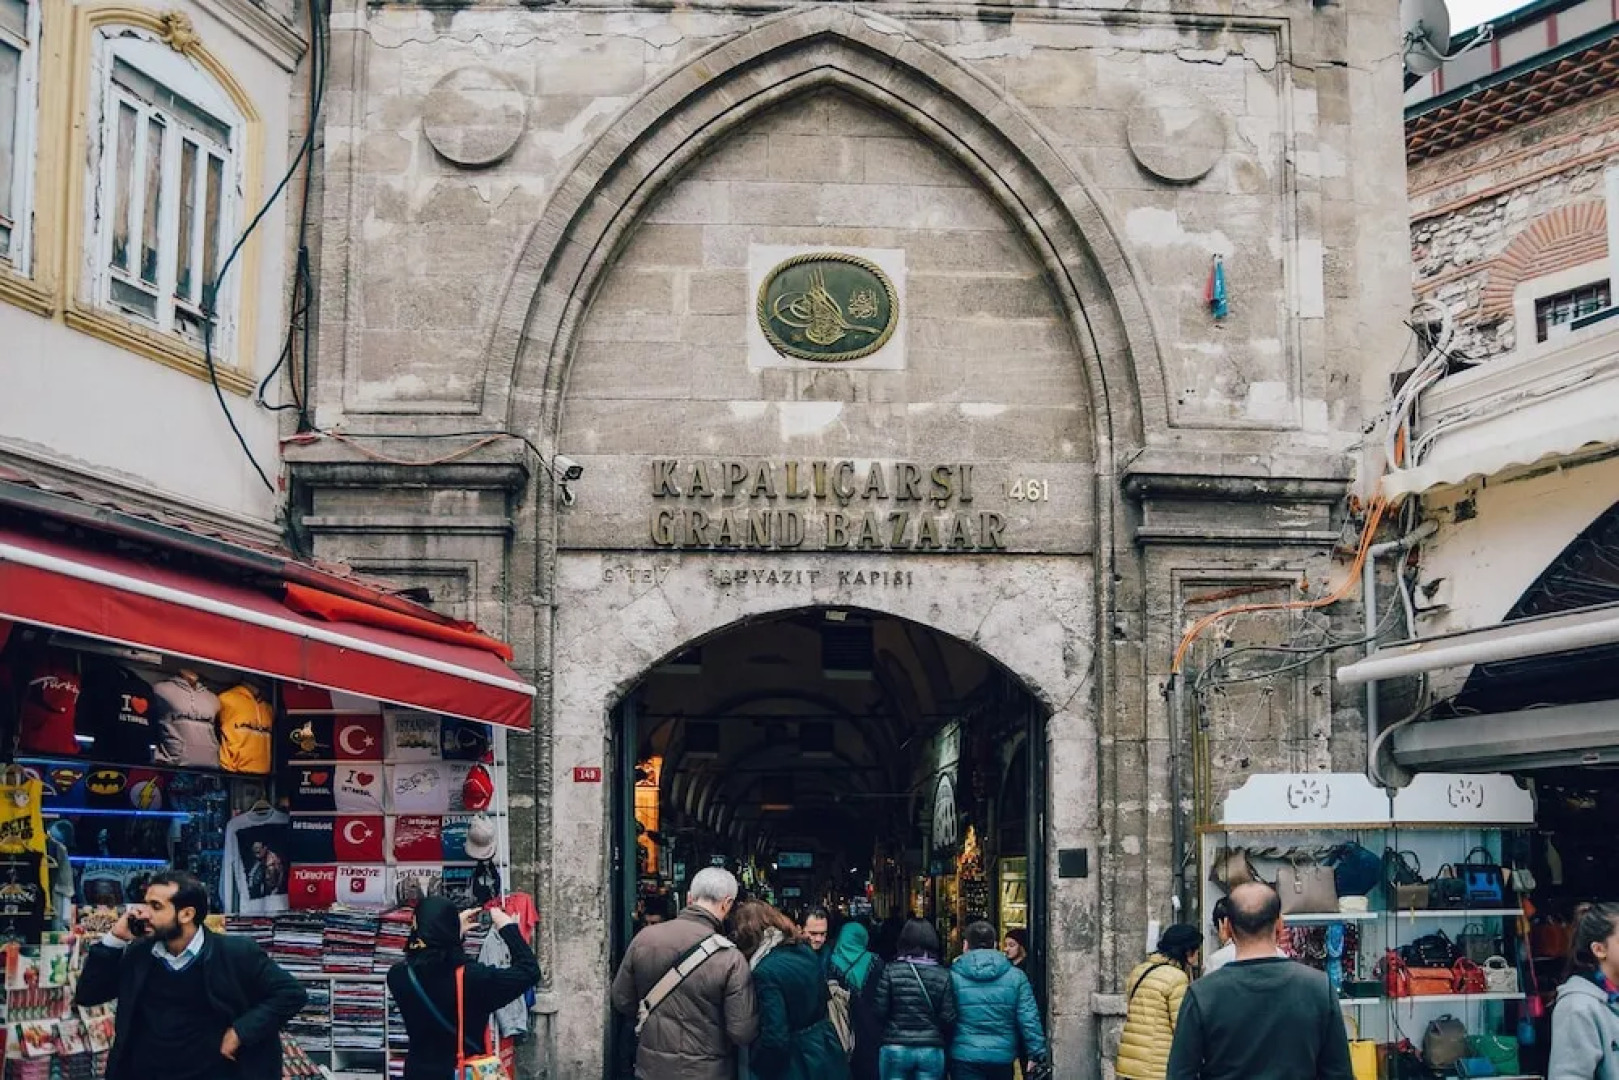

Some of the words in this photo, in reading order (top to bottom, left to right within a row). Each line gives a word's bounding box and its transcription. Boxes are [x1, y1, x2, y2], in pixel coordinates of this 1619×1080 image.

[651, 459, 974, 509] KAPALIÇARŞI
[651, 508, 805, 547] GRAND
[825, 510, 1007, 551] BAZAAR
[837, 569, 915, 589] KAPISI
[121, 694, 132, 712] I
[301, 770, 312, 786] I
[345, 769, 357, 784] I
